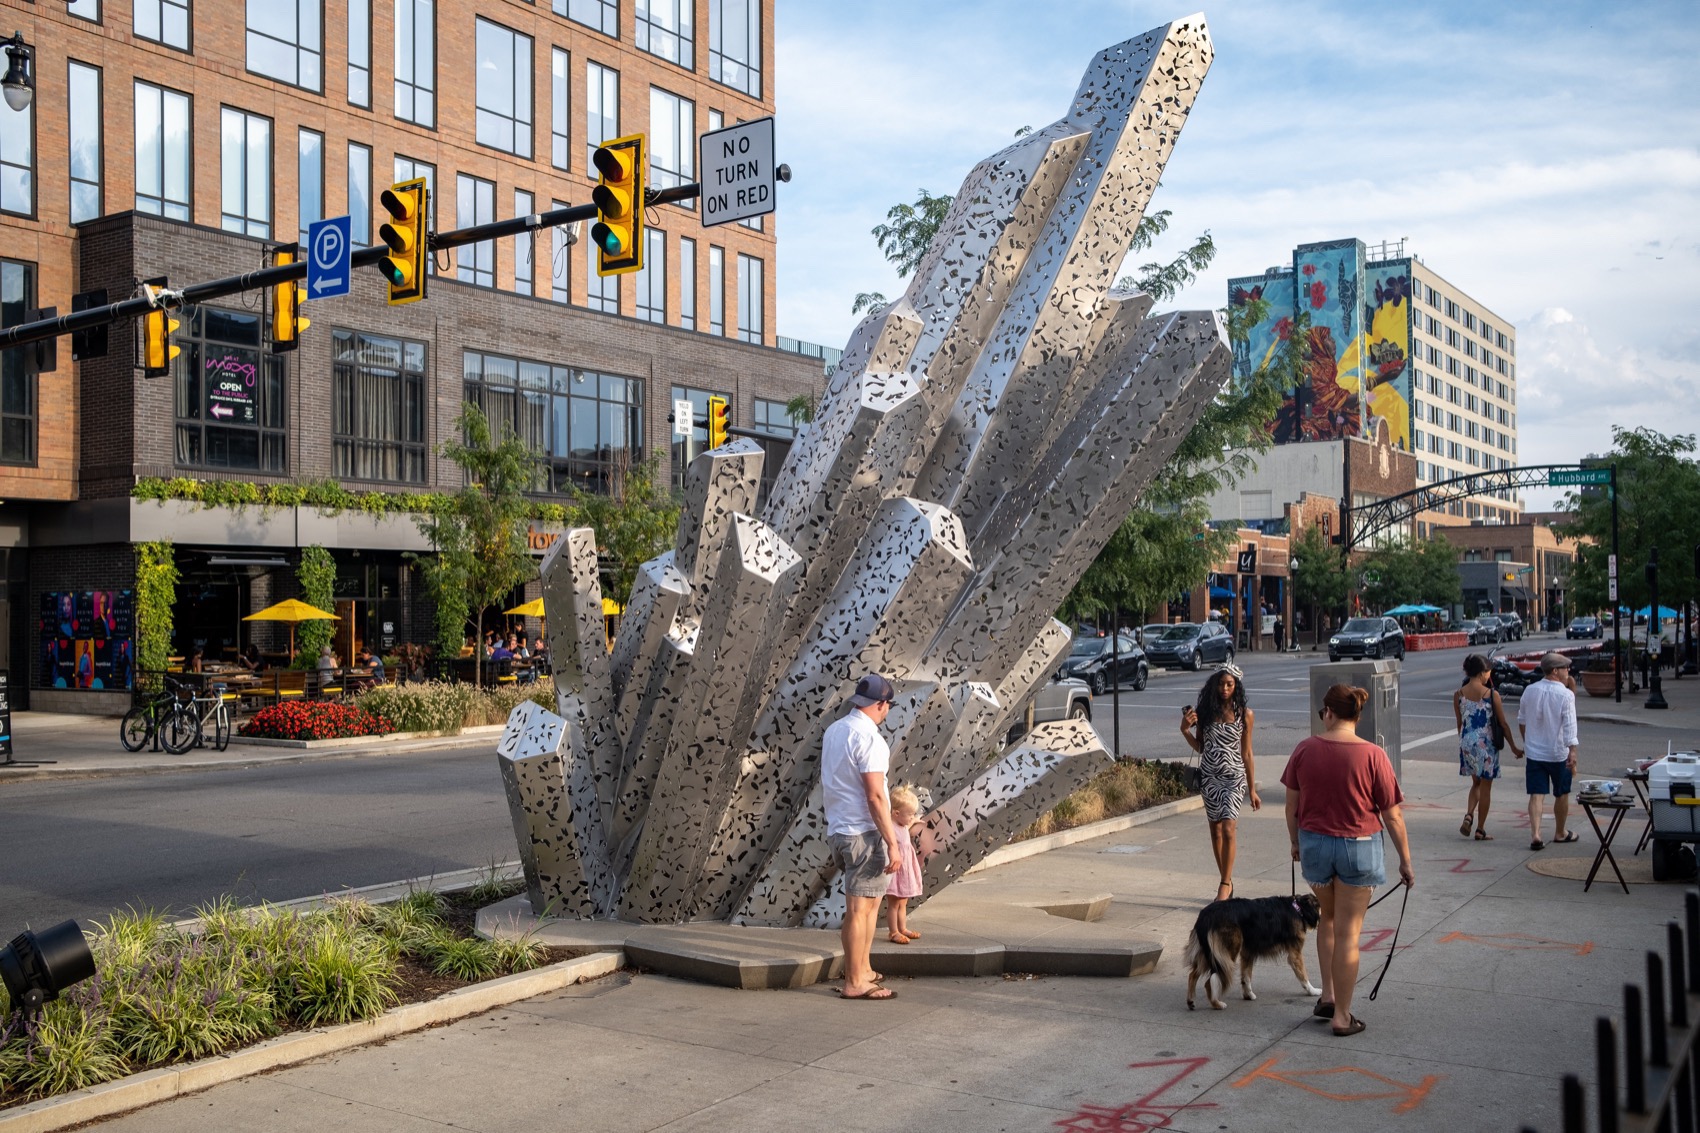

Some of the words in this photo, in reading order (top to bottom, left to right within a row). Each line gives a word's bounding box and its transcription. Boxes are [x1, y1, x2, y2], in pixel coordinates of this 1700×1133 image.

[723, 136, 750, 158] NO
[716, 160, 758, 186] TURN
[708, 193, 728, 214] ON
[737, 184, 768, 207] RED
[323, 234, 338, 262] P
[220, 382, 242, 392] OPEN
[1558, 473, 1595, 483] Hubbard
